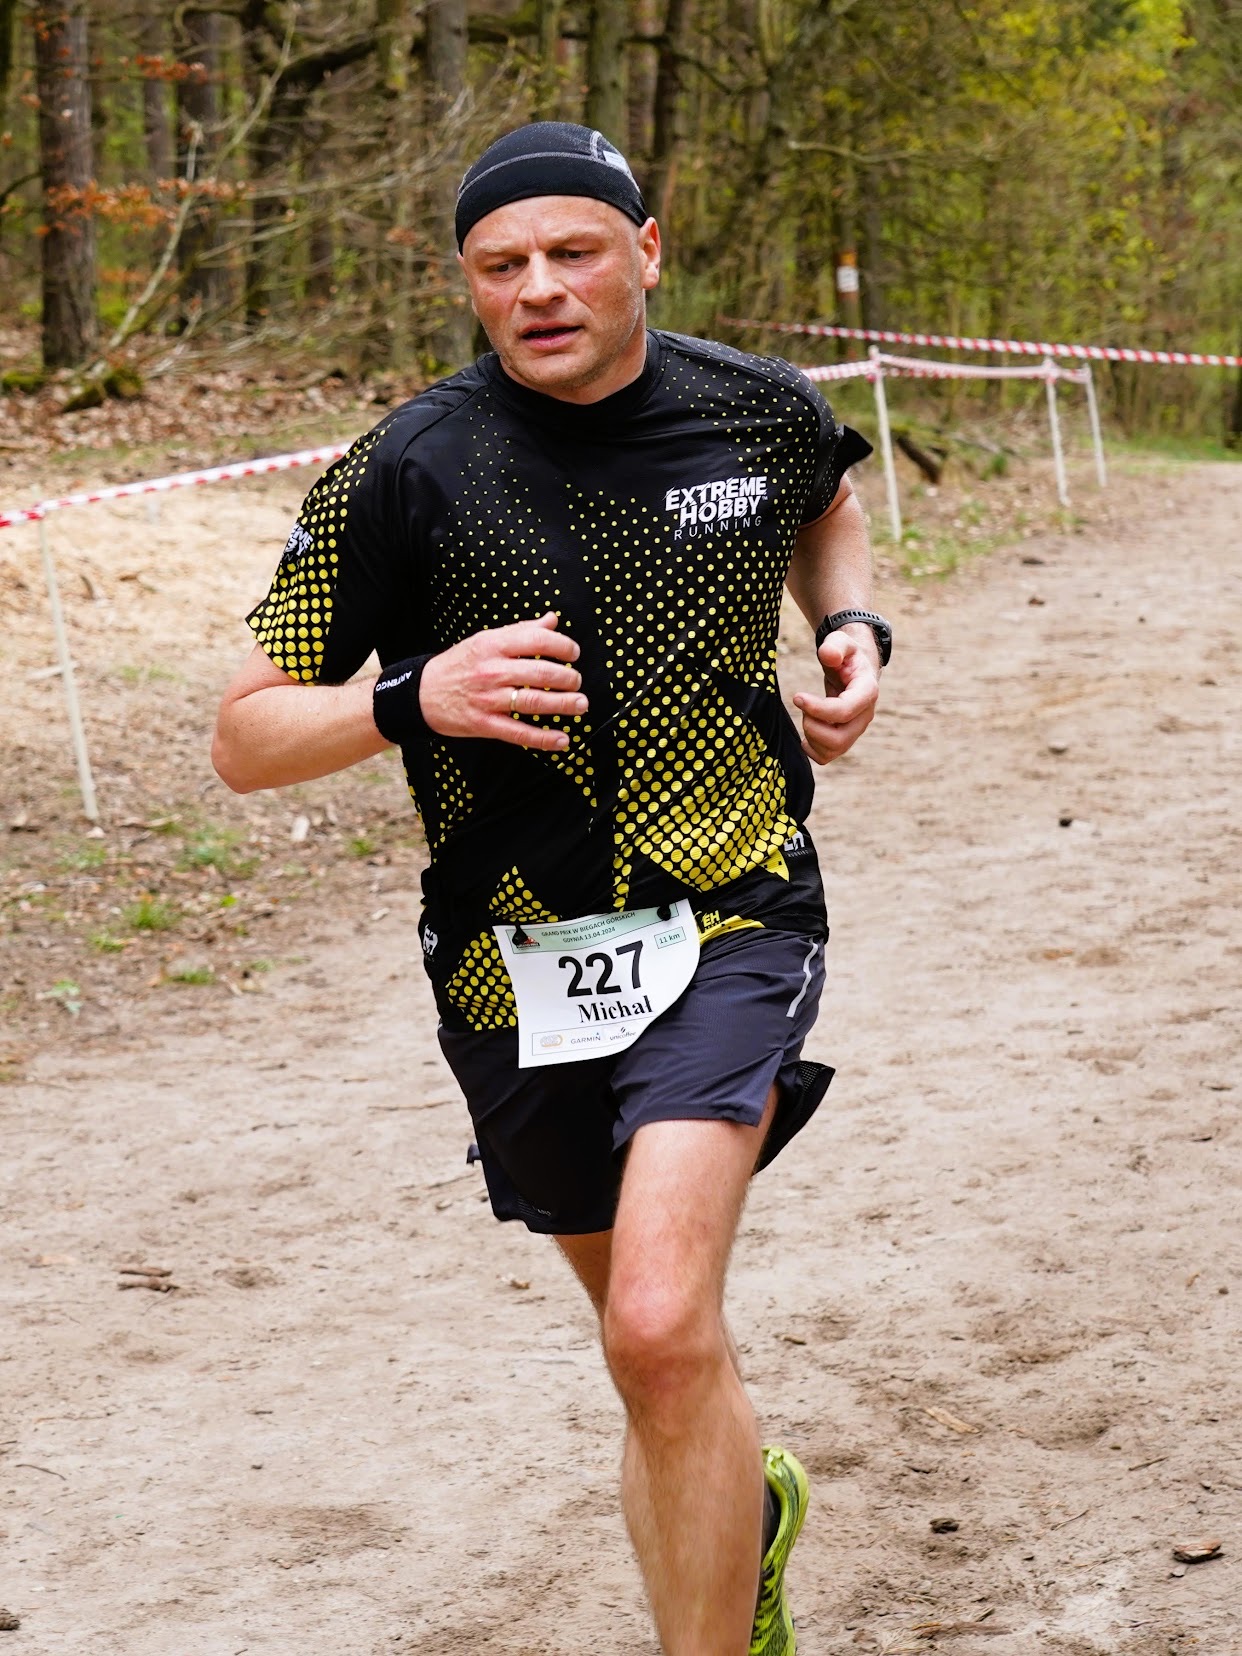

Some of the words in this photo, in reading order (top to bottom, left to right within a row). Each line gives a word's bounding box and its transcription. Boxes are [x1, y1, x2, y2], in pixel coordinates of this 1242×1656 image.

[662, 476, 768, 511] EXTREME
[680, 496, 761, 529] HOBBY
[674, 515, 762, 541] RUNNING
[375, 670, 413, 692] ARTENGO
[580, 920, 605, 932] BIEGACH
[584, 926, 616, 940] 13.04.2024
[659, 936, 668, 944] 11
[669, 933, 680, 941] km
[558, 940, 644, 998] 227
[570, 1035, 601, 1045] GARMIN
